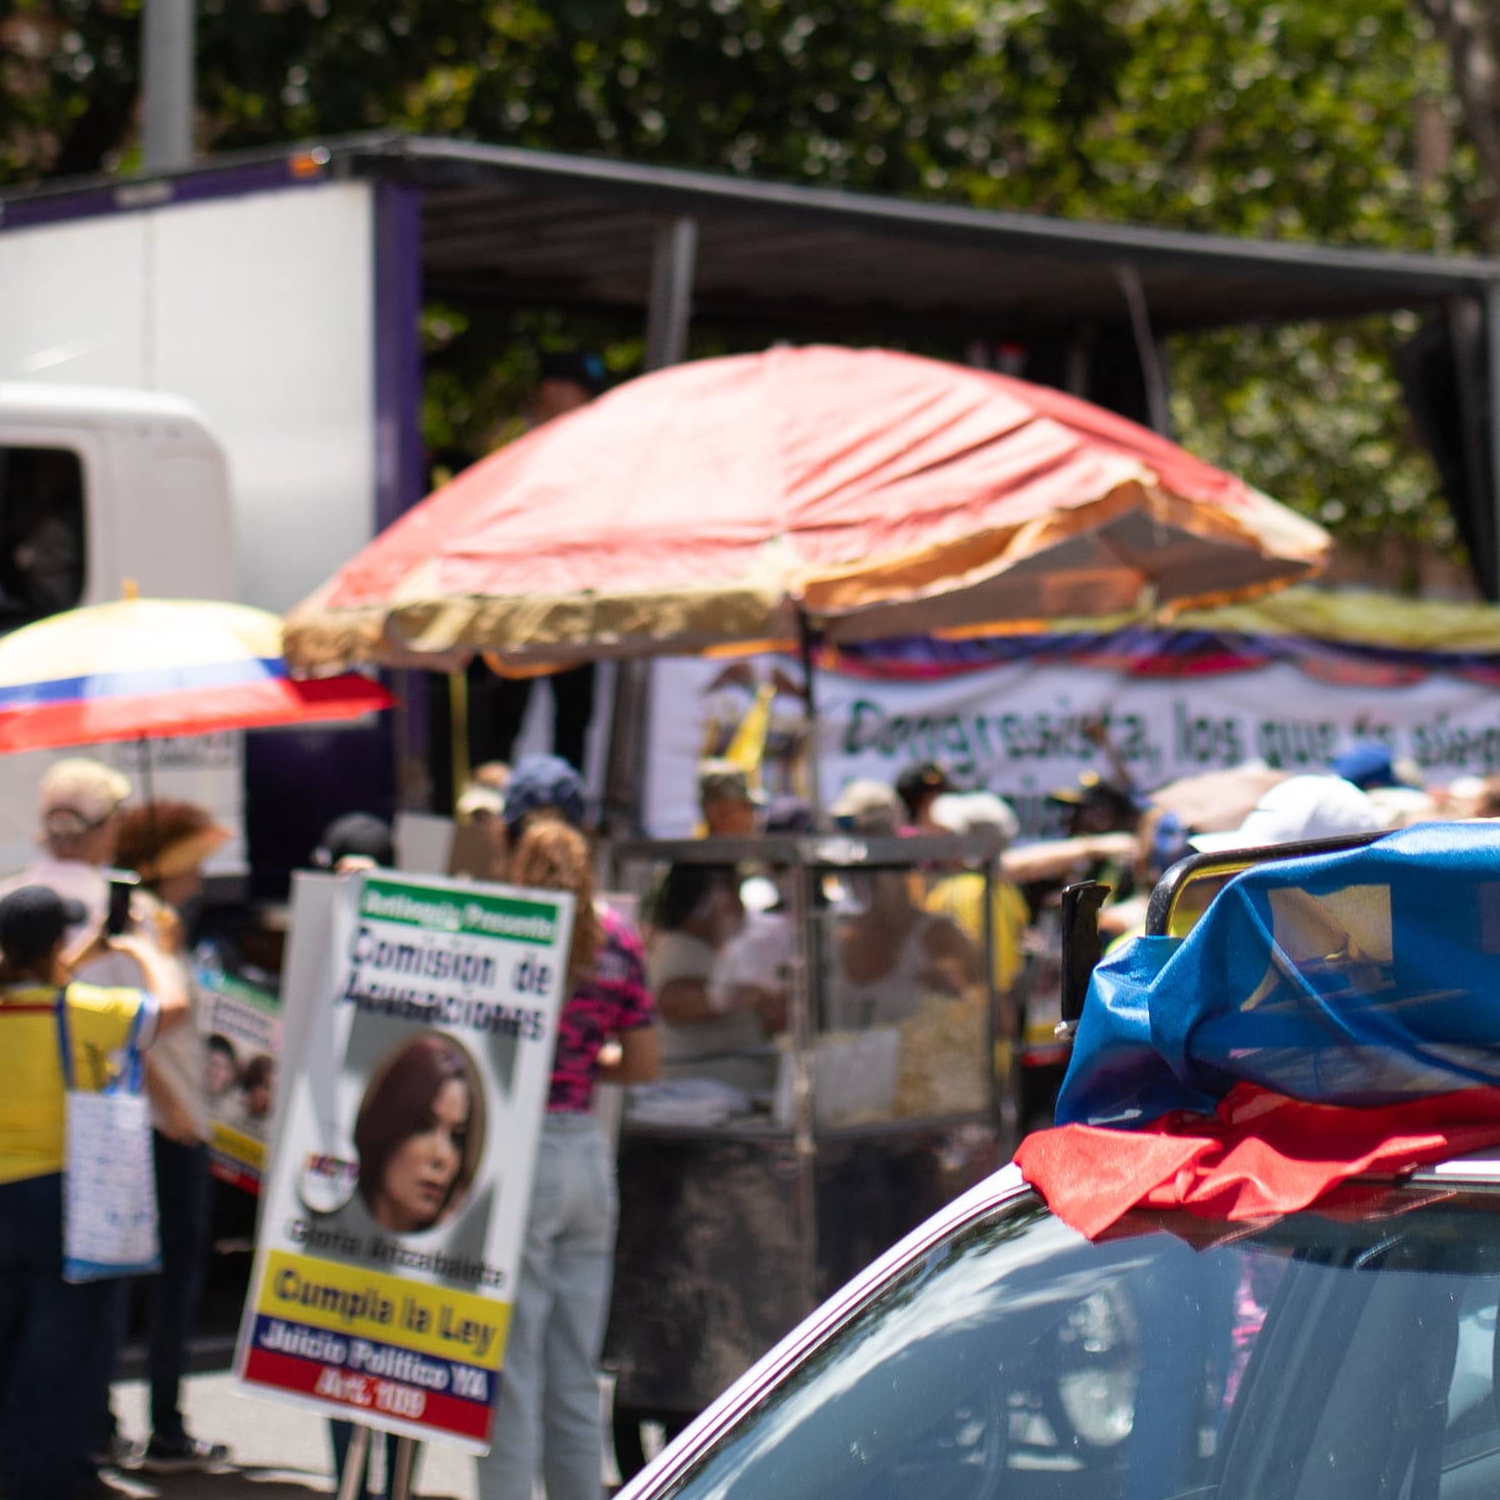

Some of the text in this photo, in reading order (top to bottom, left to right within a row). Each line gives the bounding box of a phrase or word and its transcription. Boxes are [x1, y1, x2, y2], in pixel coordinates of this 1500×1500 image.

[1176, 700, 1242, 768] los
[514, 953, 552, 994] de
[274, 1268, 498, 1357] Cumpla la Ley
[259, 1318, 348, 1366] Juicio
[450, 1364, 489, 1402] YA
